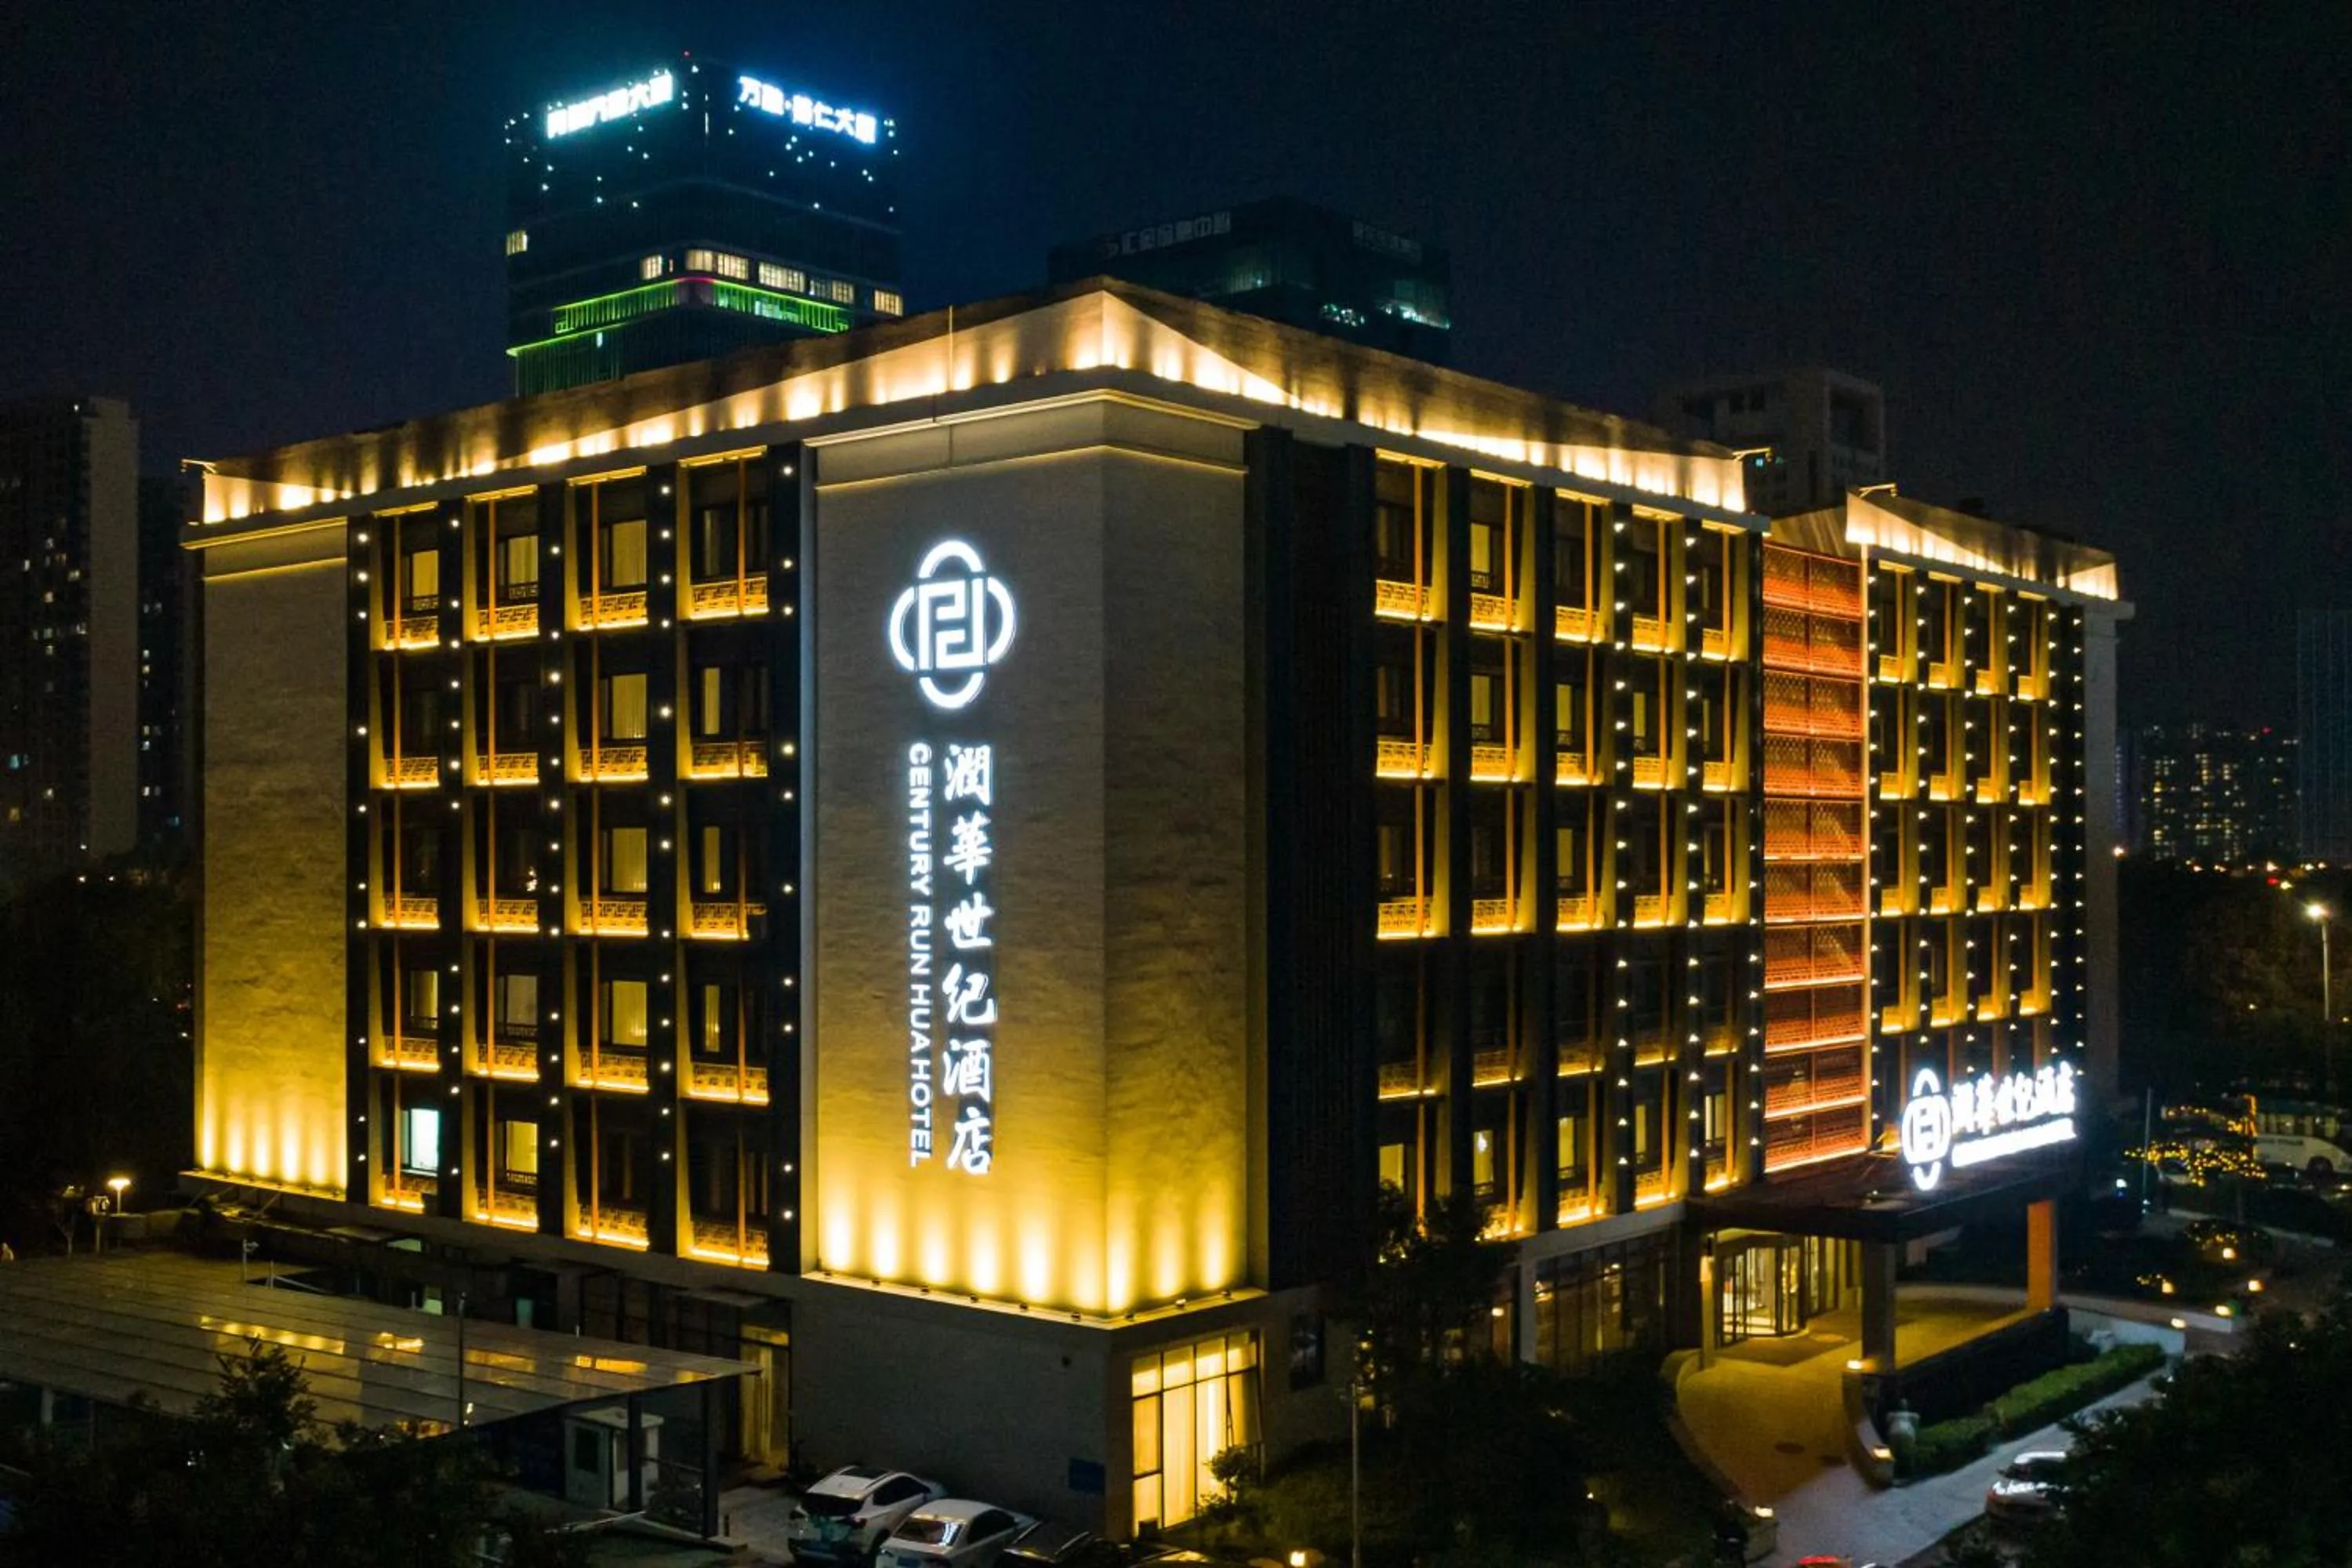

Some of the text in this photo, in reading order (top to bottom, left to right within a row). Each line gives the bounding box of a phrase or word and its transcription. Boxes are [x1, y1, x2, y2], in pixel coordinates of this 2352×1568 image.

[909, 742, 932, 1167] CENTURY RUN HUA HOTEL
